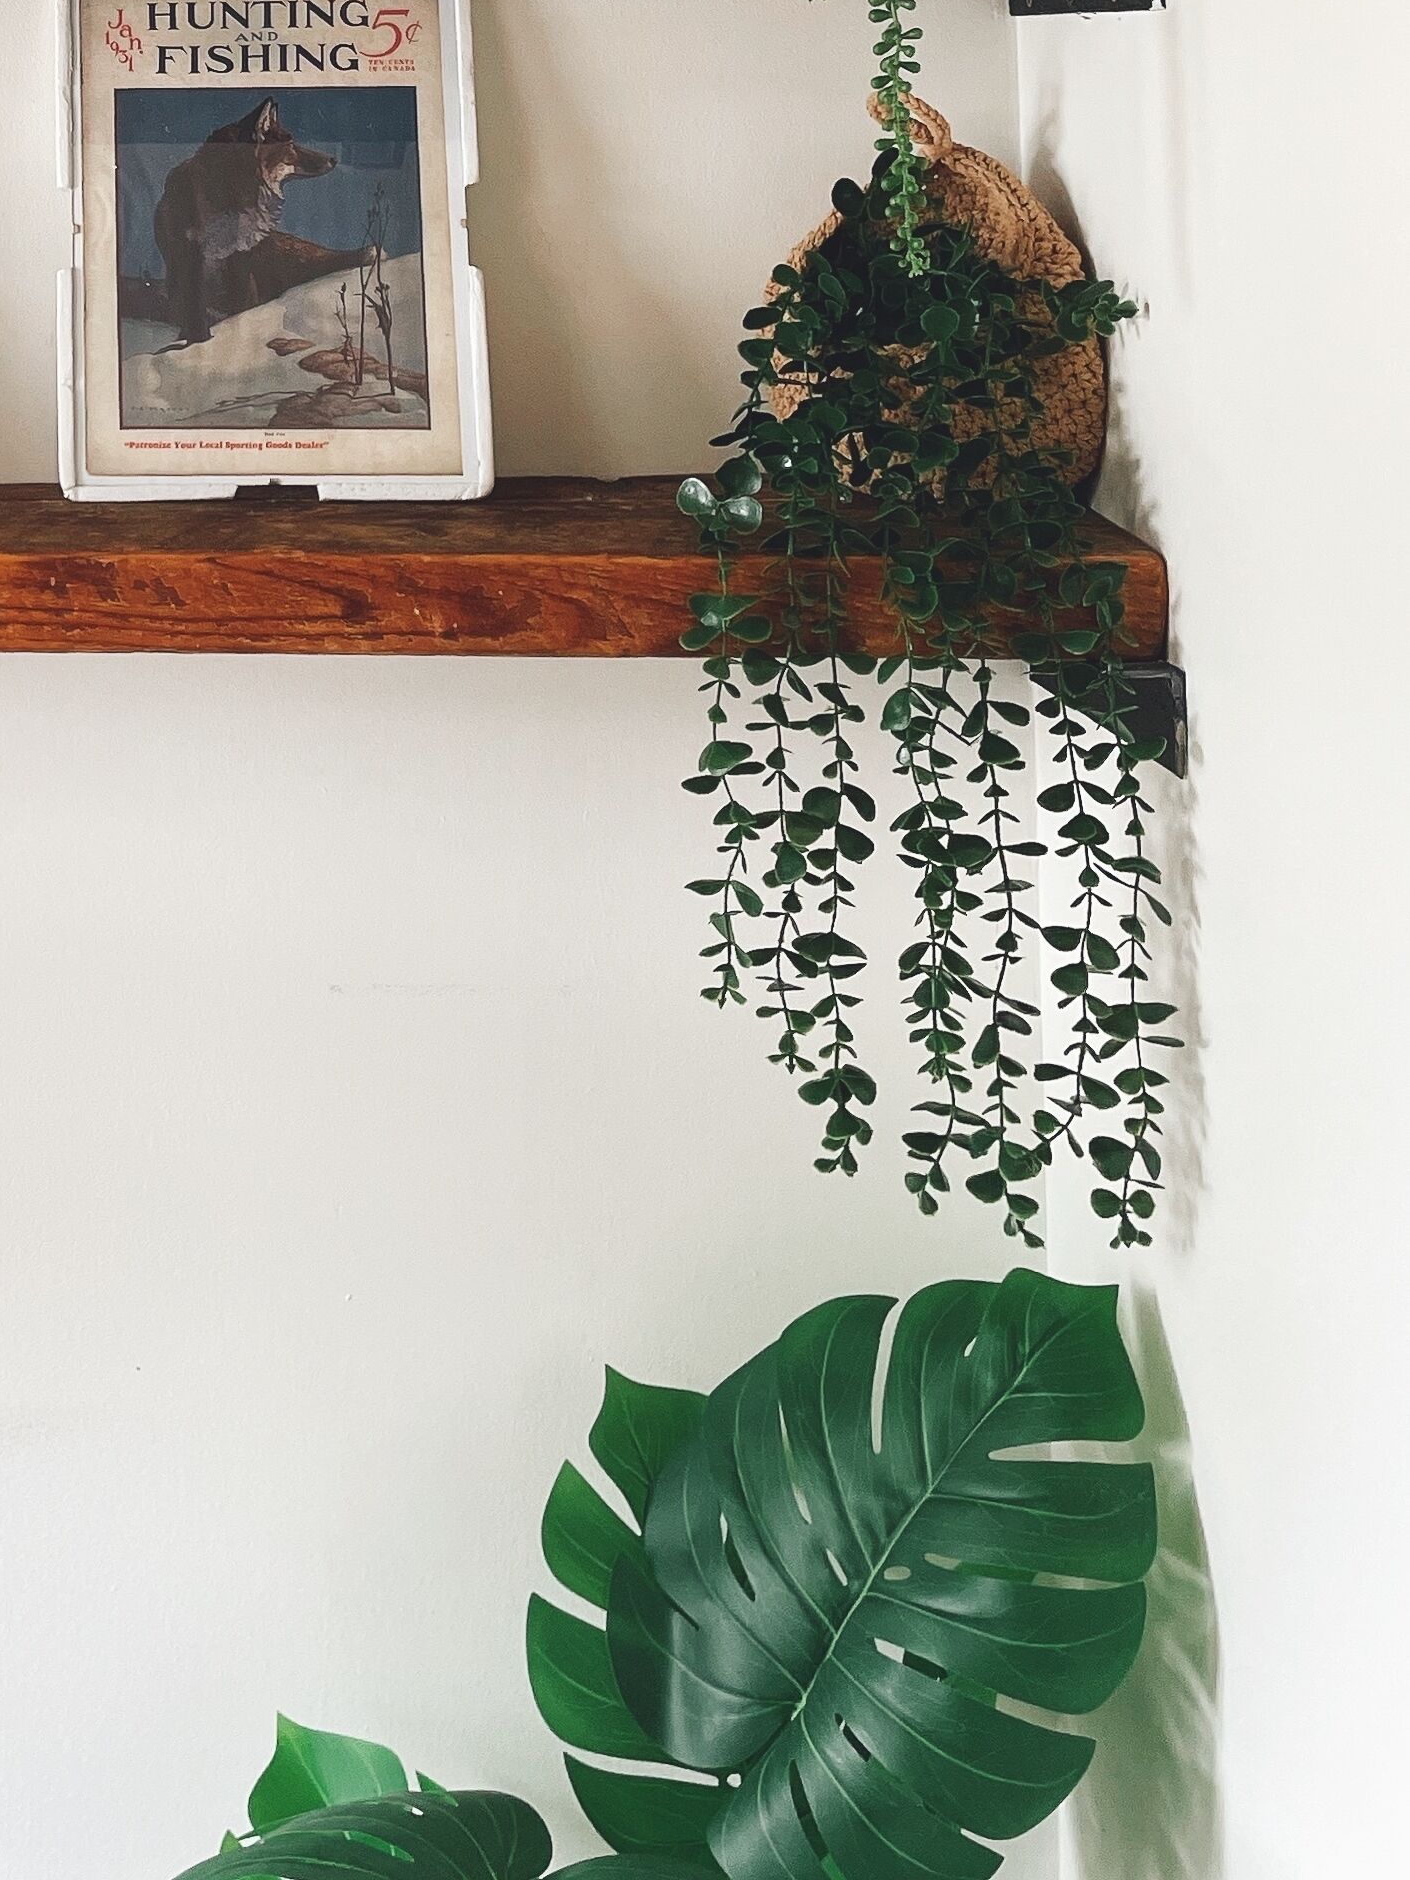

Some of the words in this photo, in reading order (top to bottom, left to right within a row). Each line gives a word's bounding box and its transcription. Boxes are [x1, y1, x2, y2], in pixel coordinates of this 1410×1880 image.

[108, 8, 143, 54] Jan.
[147, 0, 369, 31] HUNTING
[105, 30, 134, 72] 1931
[234, 31, 278, 42] AND
[156, 42, 360, 75] FISHING
[174, 441, 196, 449] Your
[199, 441, 223, 449] Local
[225, 441, 263, 451] Sporting
[265, 441, 292, 449] Goods
